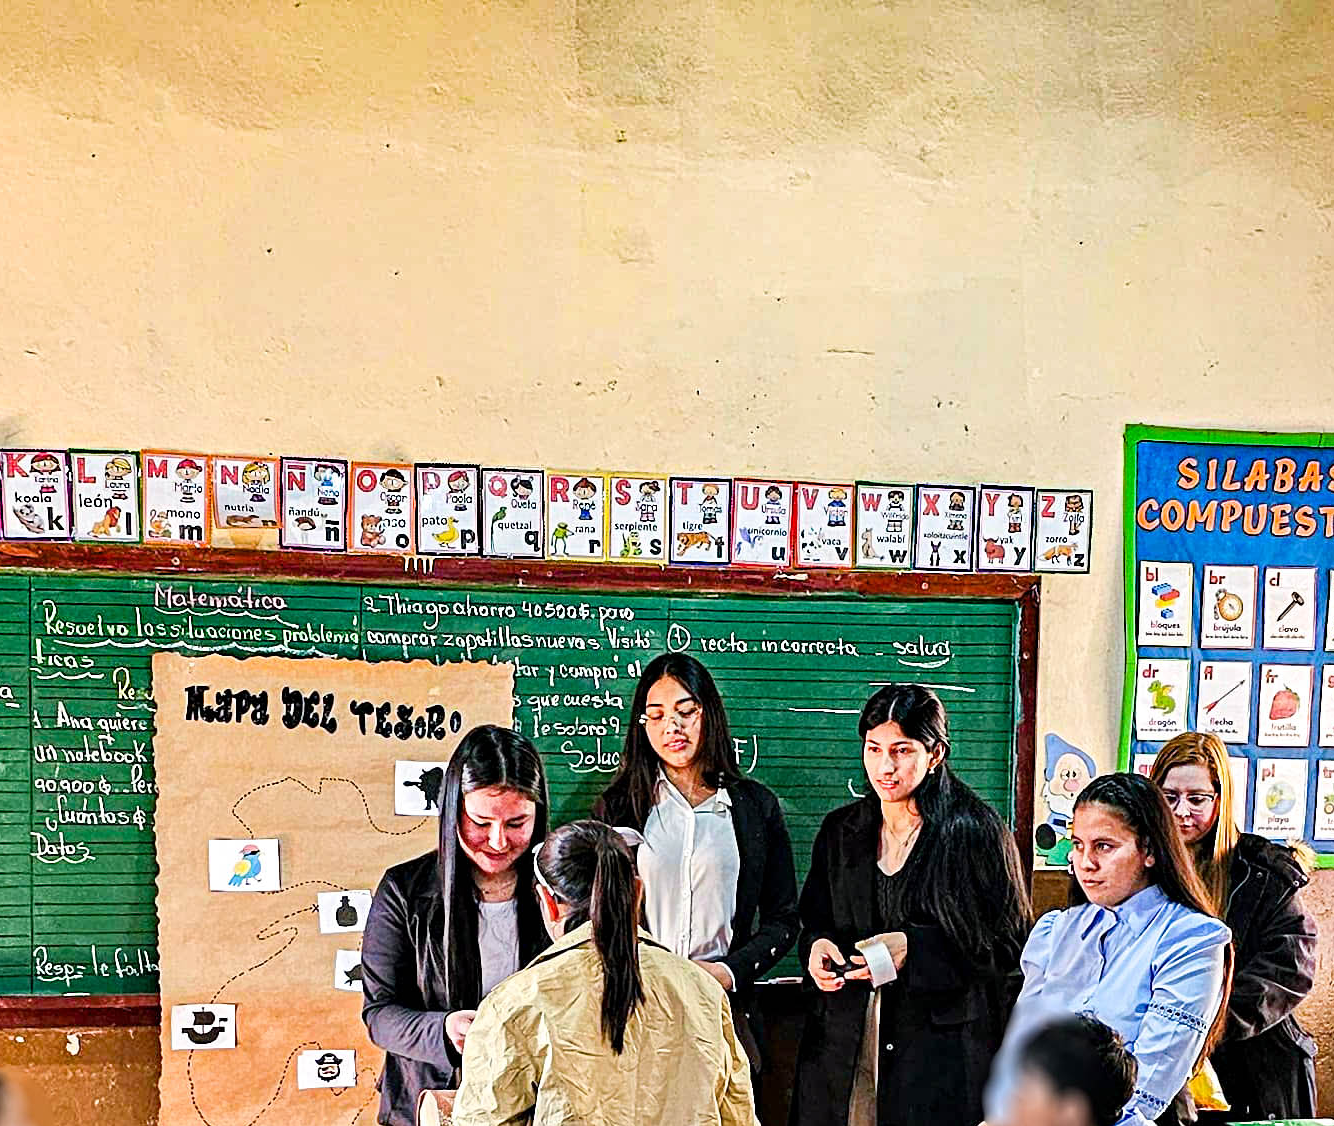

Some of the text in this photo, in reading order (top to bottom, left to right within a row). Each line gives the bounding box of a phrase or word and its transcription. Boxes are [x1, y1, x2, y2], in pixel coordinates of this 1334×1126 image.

[7, 453, 30, 478] K
[78, 457, 96, 484] L
[147, 459, 168, 479] M
[220, 464, 239, 485] N
[287, 464, 305, 491] Ñ
[356, 469, 377, 493] O
[423, 473, 439, 495] P
[488, 475, 507, 498] Q
[14, 491, 52, 504] koala
[551, 477, 569, 502] R
[615, 479, 631, 505] S
[676, 482, 693, 505] T
[741, 487, 759, 509] U
[802, 488, 819, 509] V
[79, 493, 112, 509] león
[224, 503, 254, 514] nutria
[861, 493, 883, 511] W
[923, 493, 939, 516] X
[984, 493, 999, 517] Y
[1041, 496, 1056, 518] Z
[167, 508, 201, 520] mono
[422, 514, 448, 528] pato
[179, 523, 202, 541] m
[498, 520, 532, 533] quetzal
[575, 524, 595, 534] rana
[615, 522, 658, 533] serpiente
[1045, 535, 1068, 544] zorro
[1074, 553, 1084, 567] z
[1145, 567, 1158, 581] bl
[1209, 570, 1226, 584] br
[1142, 664, 1159, 678] dr
[62, 736, 147, 763] notebook
